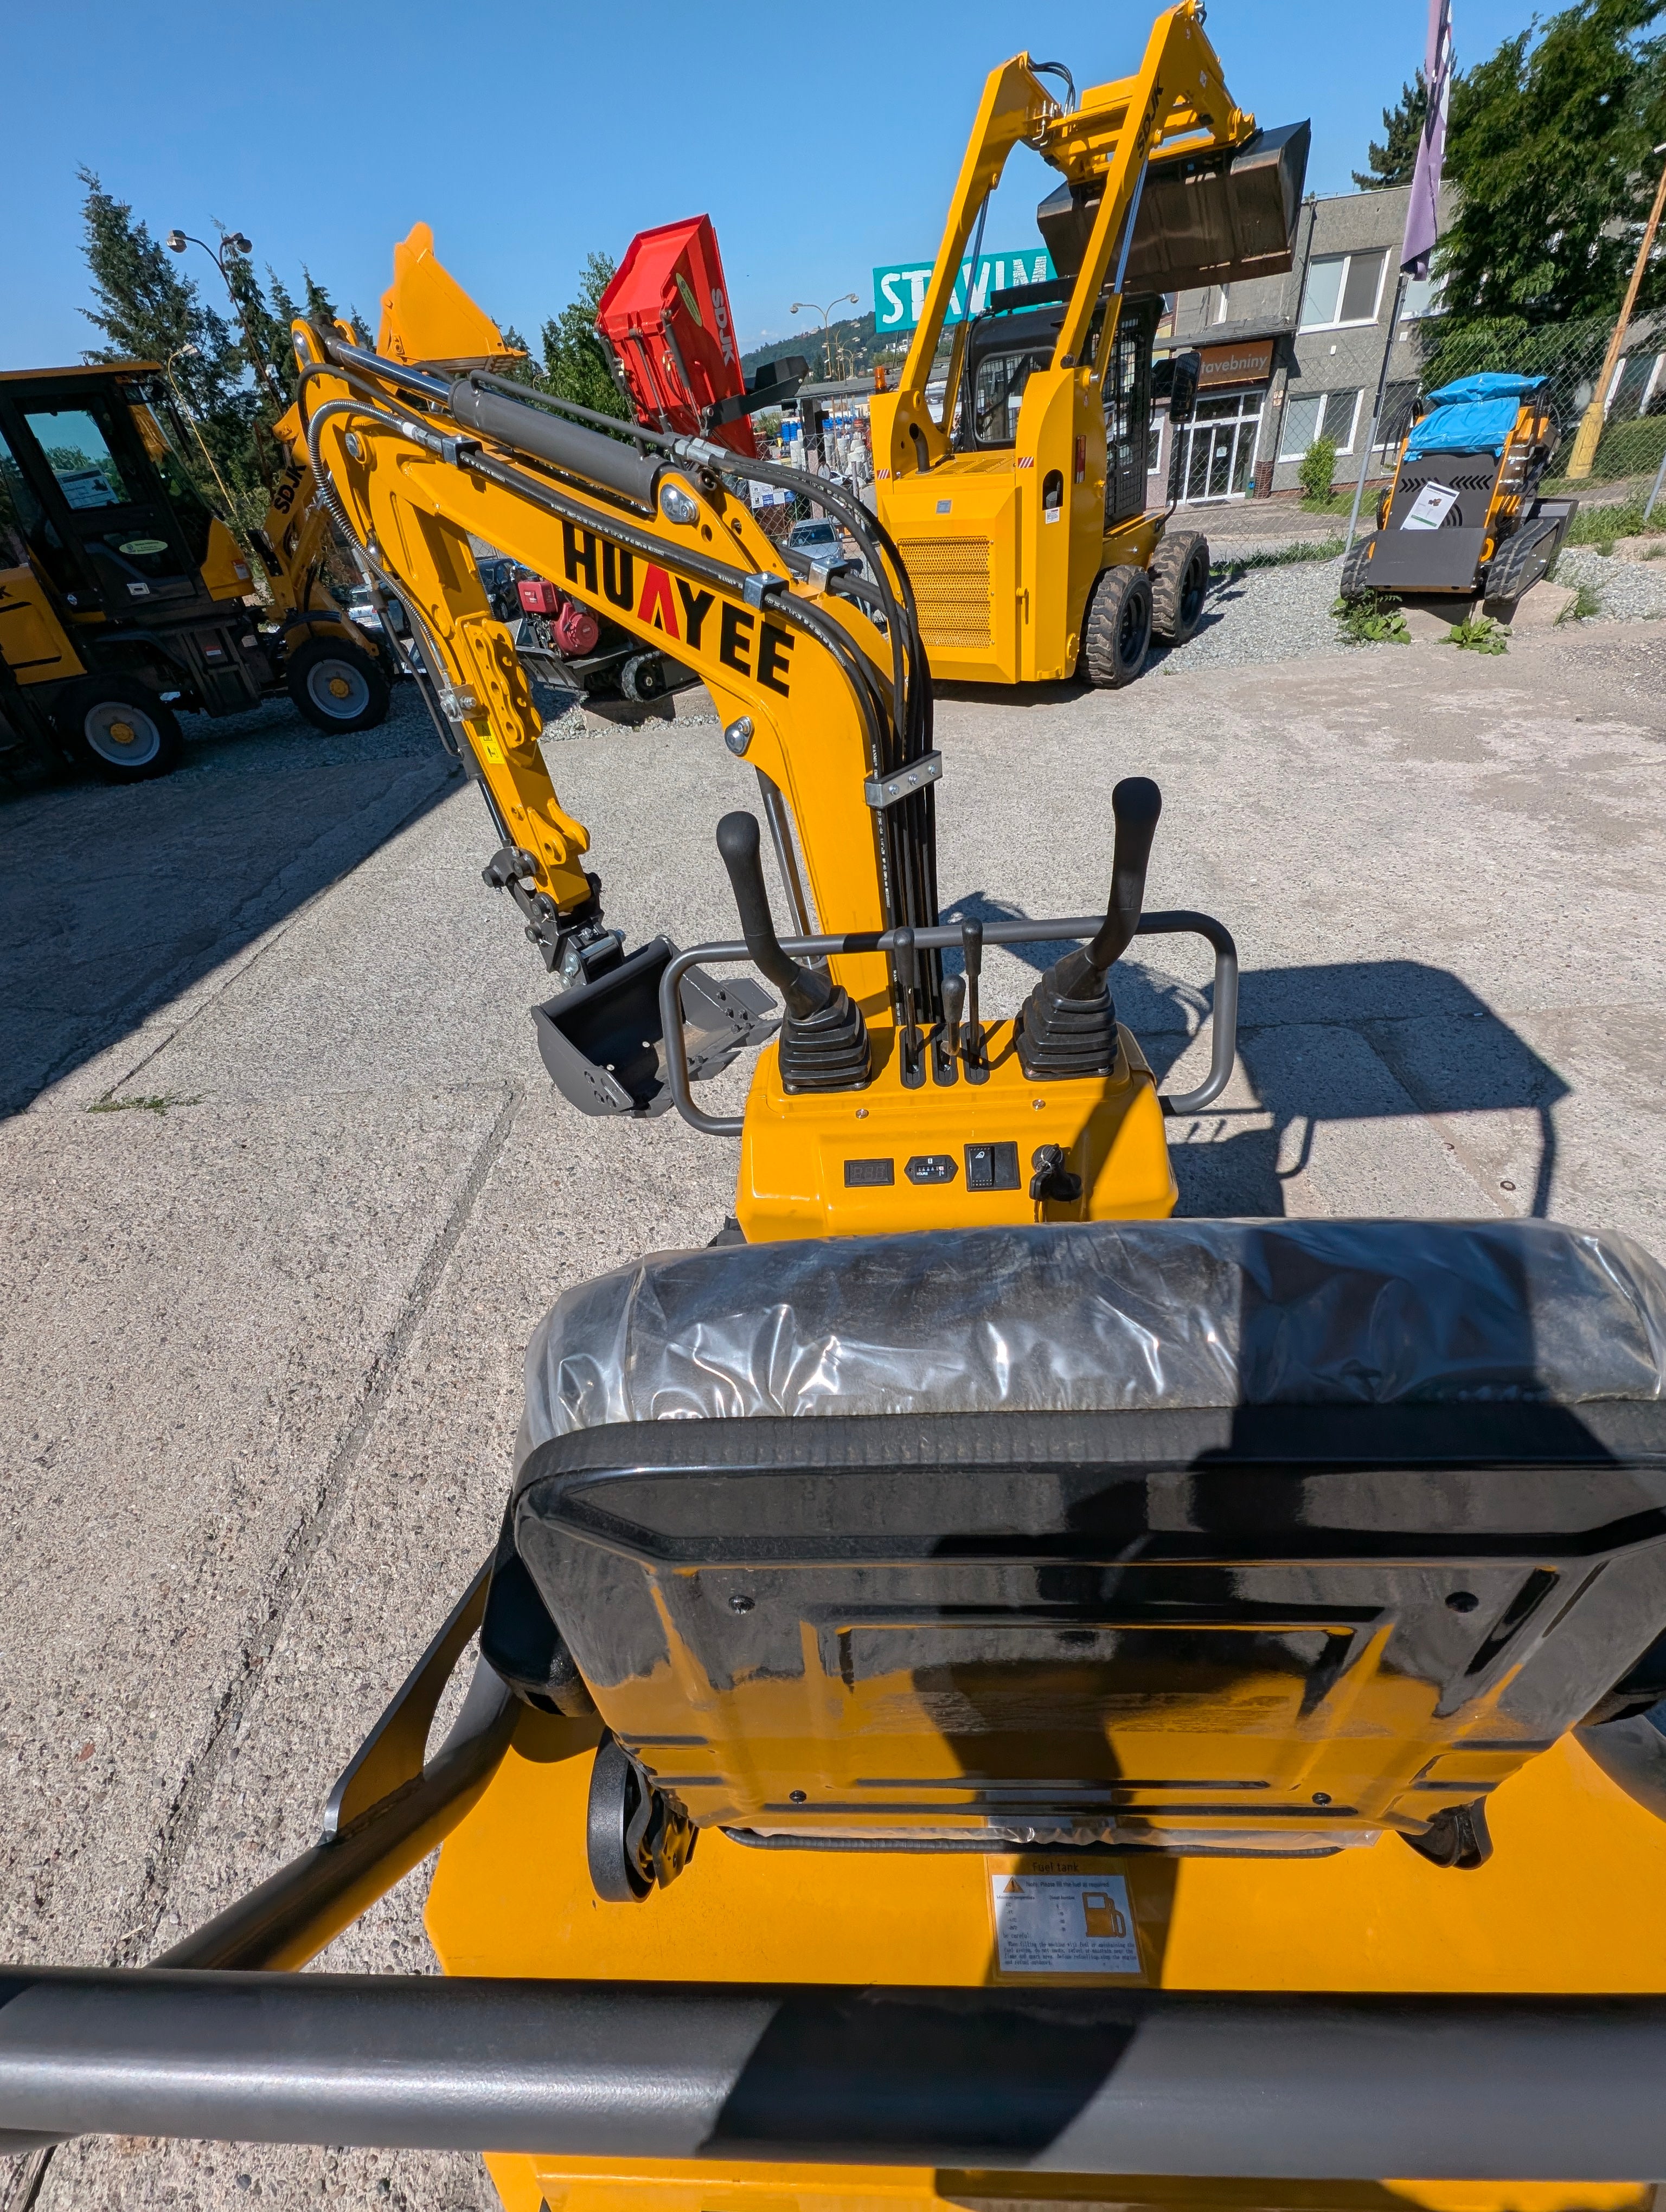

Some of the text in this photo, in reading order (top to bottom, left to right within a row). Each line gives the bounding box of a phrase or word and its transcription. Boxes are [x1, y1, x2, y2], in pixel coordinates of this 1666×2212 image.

[711, 288, 735, 367] SDJK
[1200, 353, 1268, 374] tavebniny
[273, 465, 307, 514] SDJK
[561, 519, 796, 698] HUAYEE
[1032, 1862, 1078, 1872] Fuel tank
